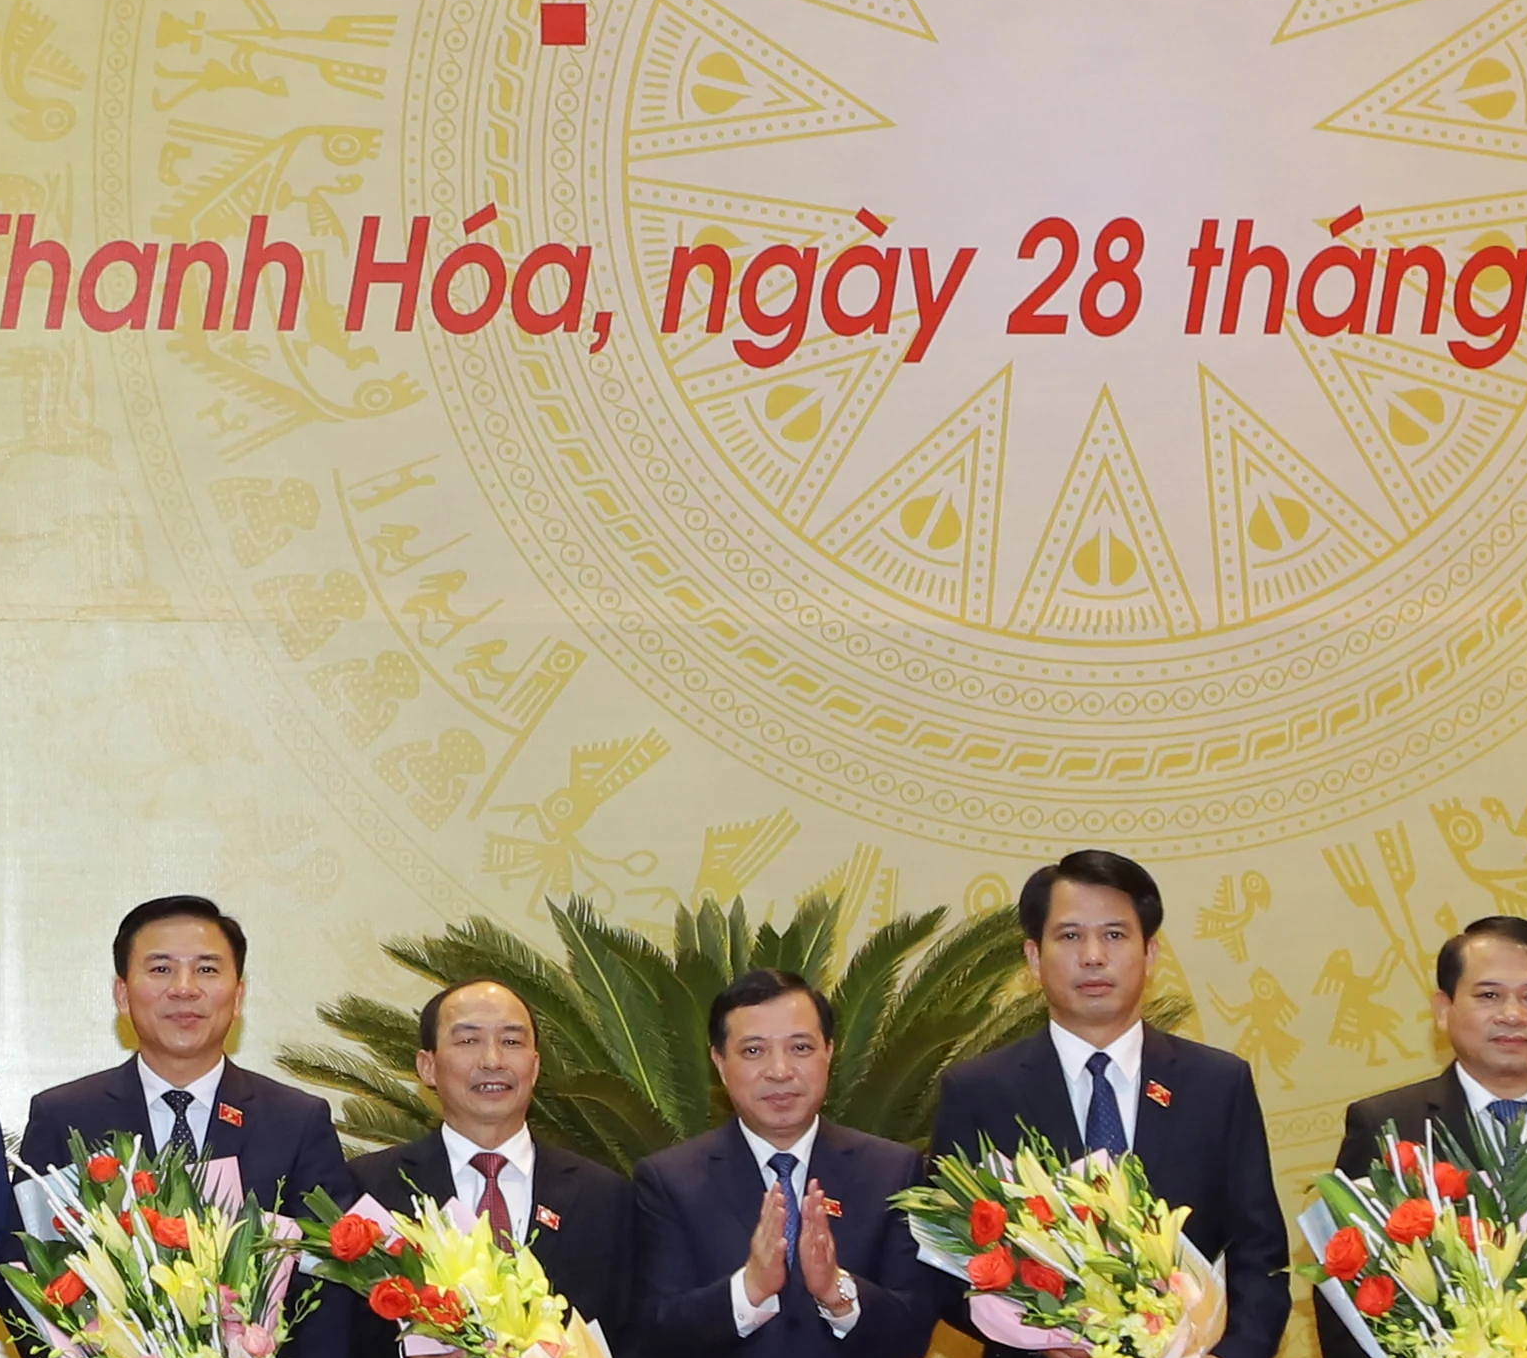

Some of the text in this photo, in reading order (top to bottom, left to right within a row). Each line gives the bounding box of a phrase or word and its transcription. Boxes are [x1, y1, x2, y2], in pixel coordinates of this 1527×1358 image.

[346, 203, 613, 354] Hóa,
[662, 208, 977, 369] ngày
[1006, 216, 1145, 338] 28
